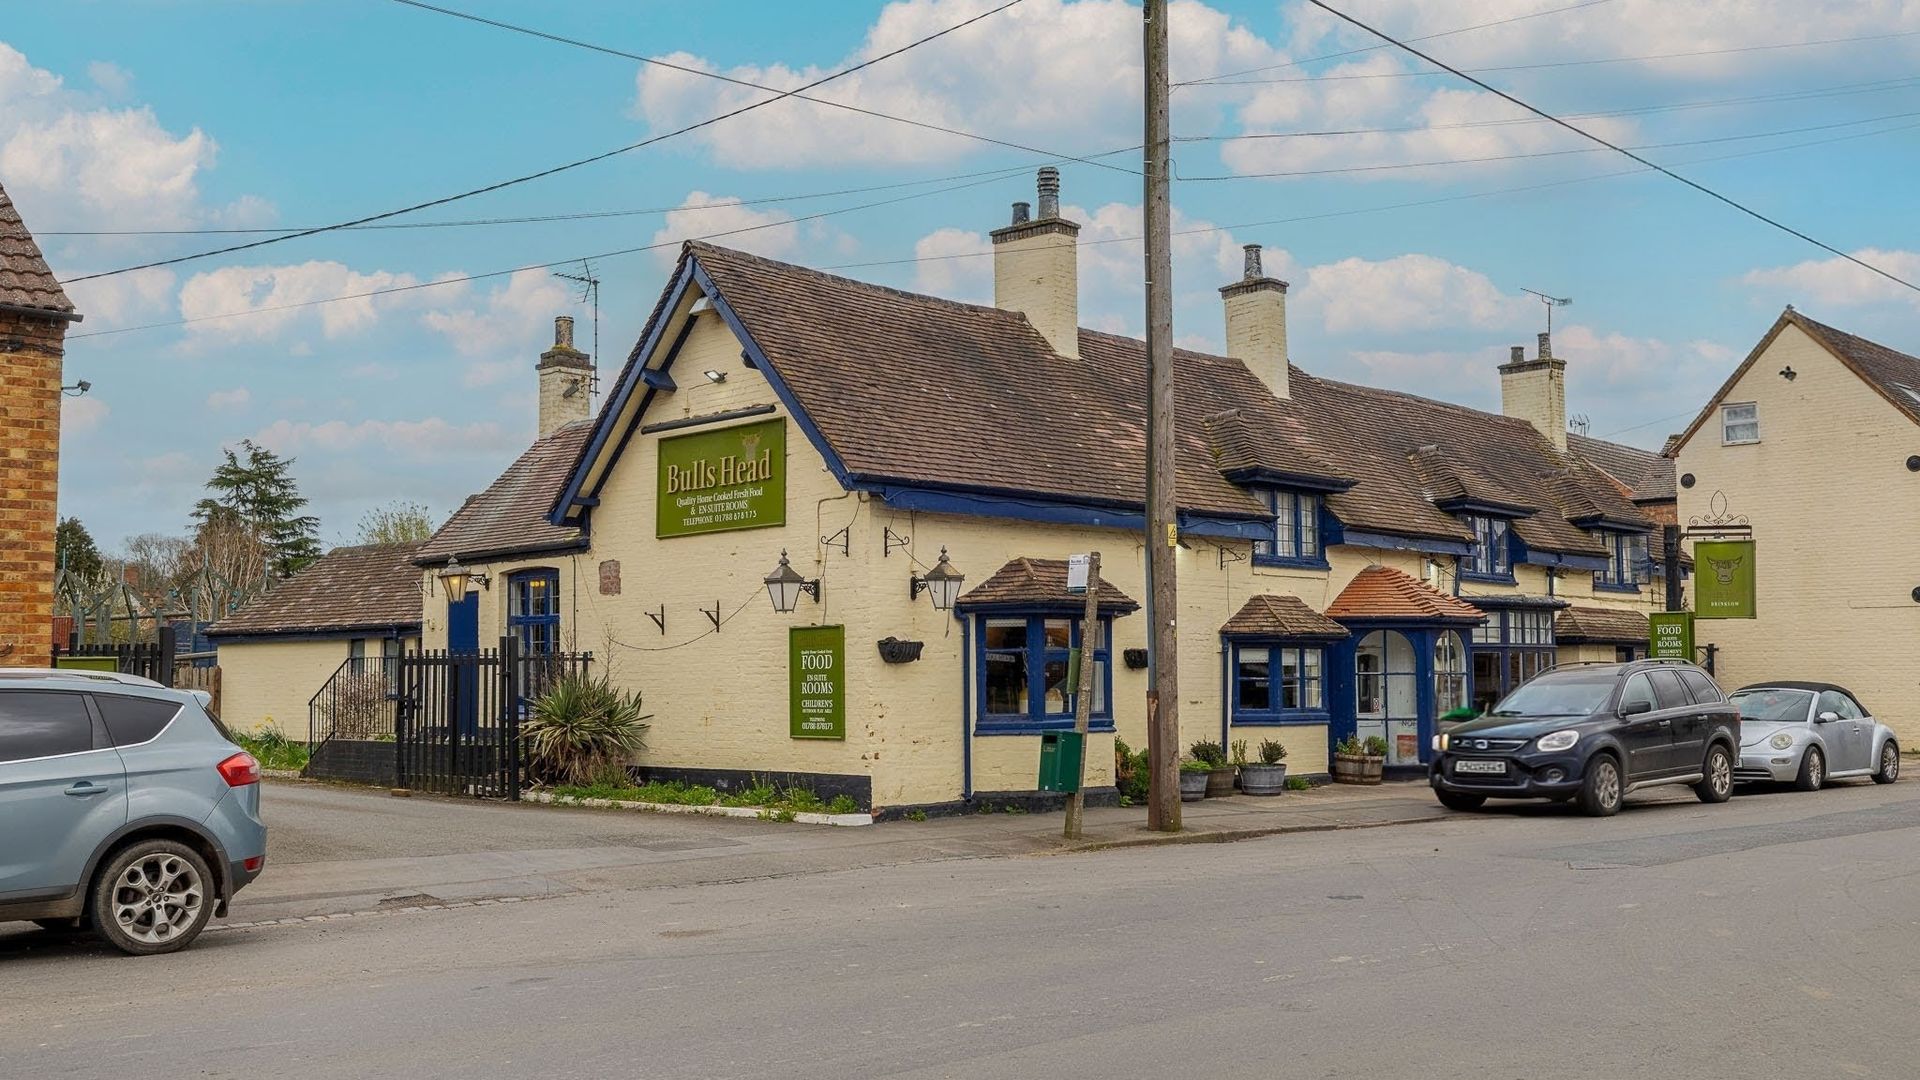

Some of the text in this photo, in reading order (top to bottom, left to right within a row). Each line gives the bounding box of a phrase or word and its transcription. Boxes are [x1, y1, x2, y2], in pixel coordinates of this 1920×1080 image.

[666, 448, 772, 494] Bulls Head
[676, 487, 763, 507] Quality Home Cooked Fresh Food
[690, 506, 696, 515] &
[725, 500, 748, 511] ROOMS
[683, 515, 714, 526] TELEPHONE
[714, 512, 733, 522] 01788
[1657, 626, 1682, 635] FOOD
[1657, 640, 1683, 648] ROOMS
[801, 654, 833, 670] FOOD
[801, 681, 833, 694] ROOMS
[801, 699, 833, 708] CHILDREN'S
